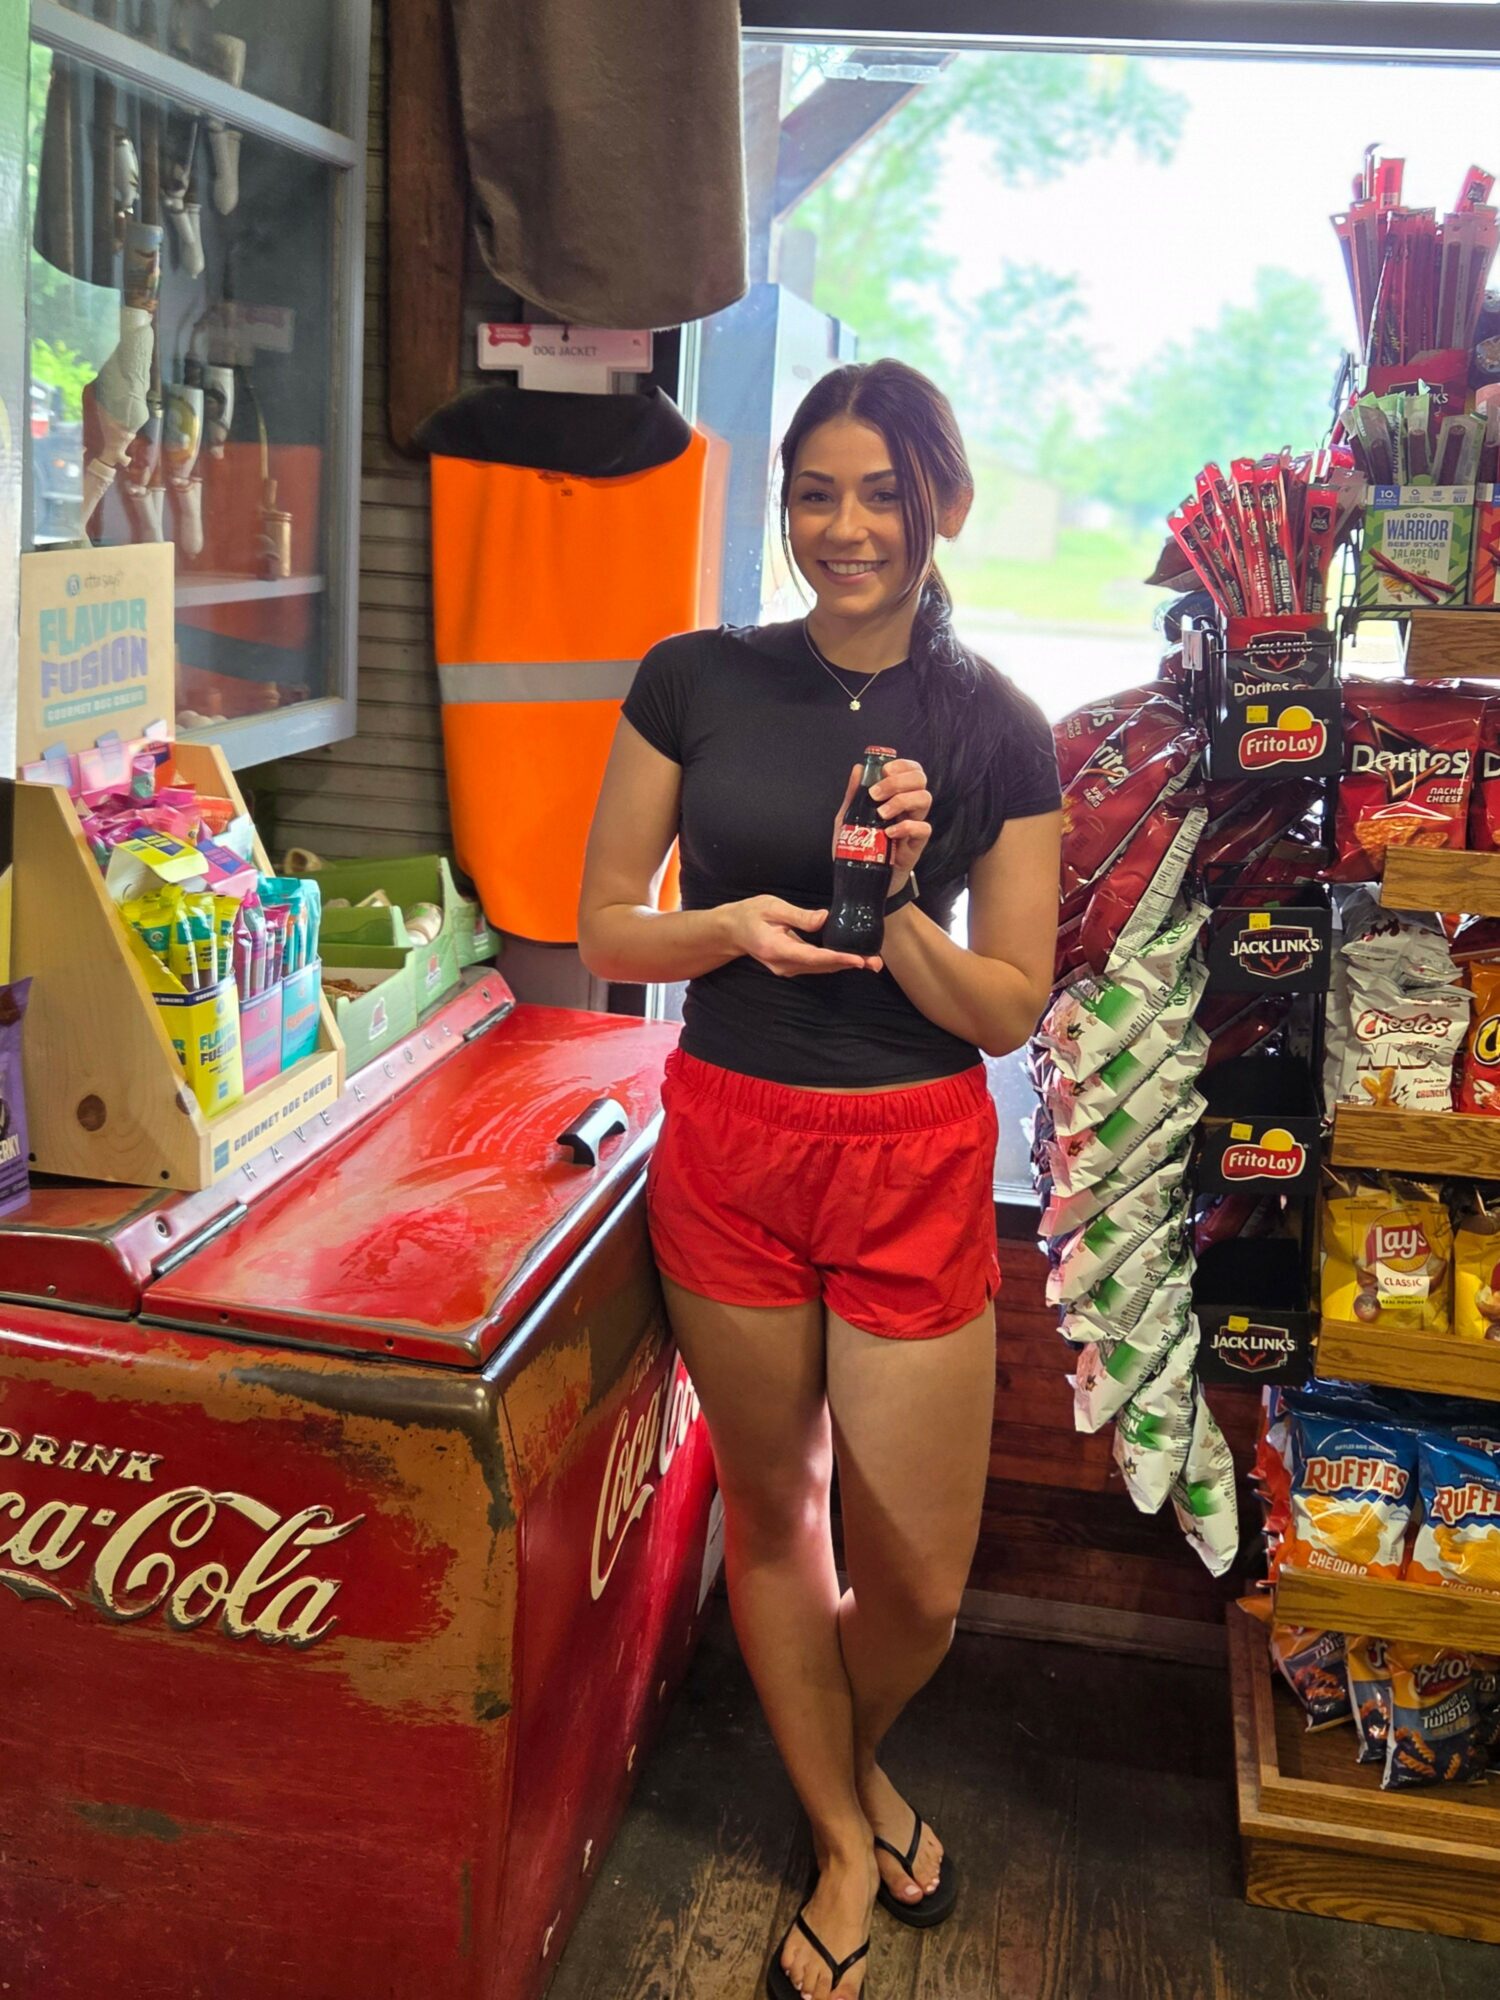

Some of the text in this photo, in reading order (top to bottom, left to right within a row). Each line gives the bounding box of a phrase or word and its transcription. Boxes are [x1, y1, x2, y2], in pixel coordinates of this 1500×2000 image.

[533, 346, 597, 357] DOG JACKET
[1387, 519, 1449, 541] WARRIOR
[39, 598, 147, 657] FLAVOR
[41, 635, 148, 699] FUSION
[1352, 744, 1467, 775] Doritos
[1426, 795, 1463, 803] CHEESE
[1430, 787, 1464, 796] NACHO
[1229, 940, 1271, 957] JACK
[1355, 1008, 1452, 1042] Cheetos
[234, 1074, 333, 1152] GOURMET DOG CHEWS
[1384, 1277, 1422, 1287] CLASSIC
[1210, 1334, 1250, 1350] JACK
[0, 1427, 164, 1482] DRINK
[1303, 1456, 1410, 1499] RUFFLES
[1308, 1550, 1368, 1577] CHEDDAR
[1421, 1694, 1471, 1729] TWISTS
